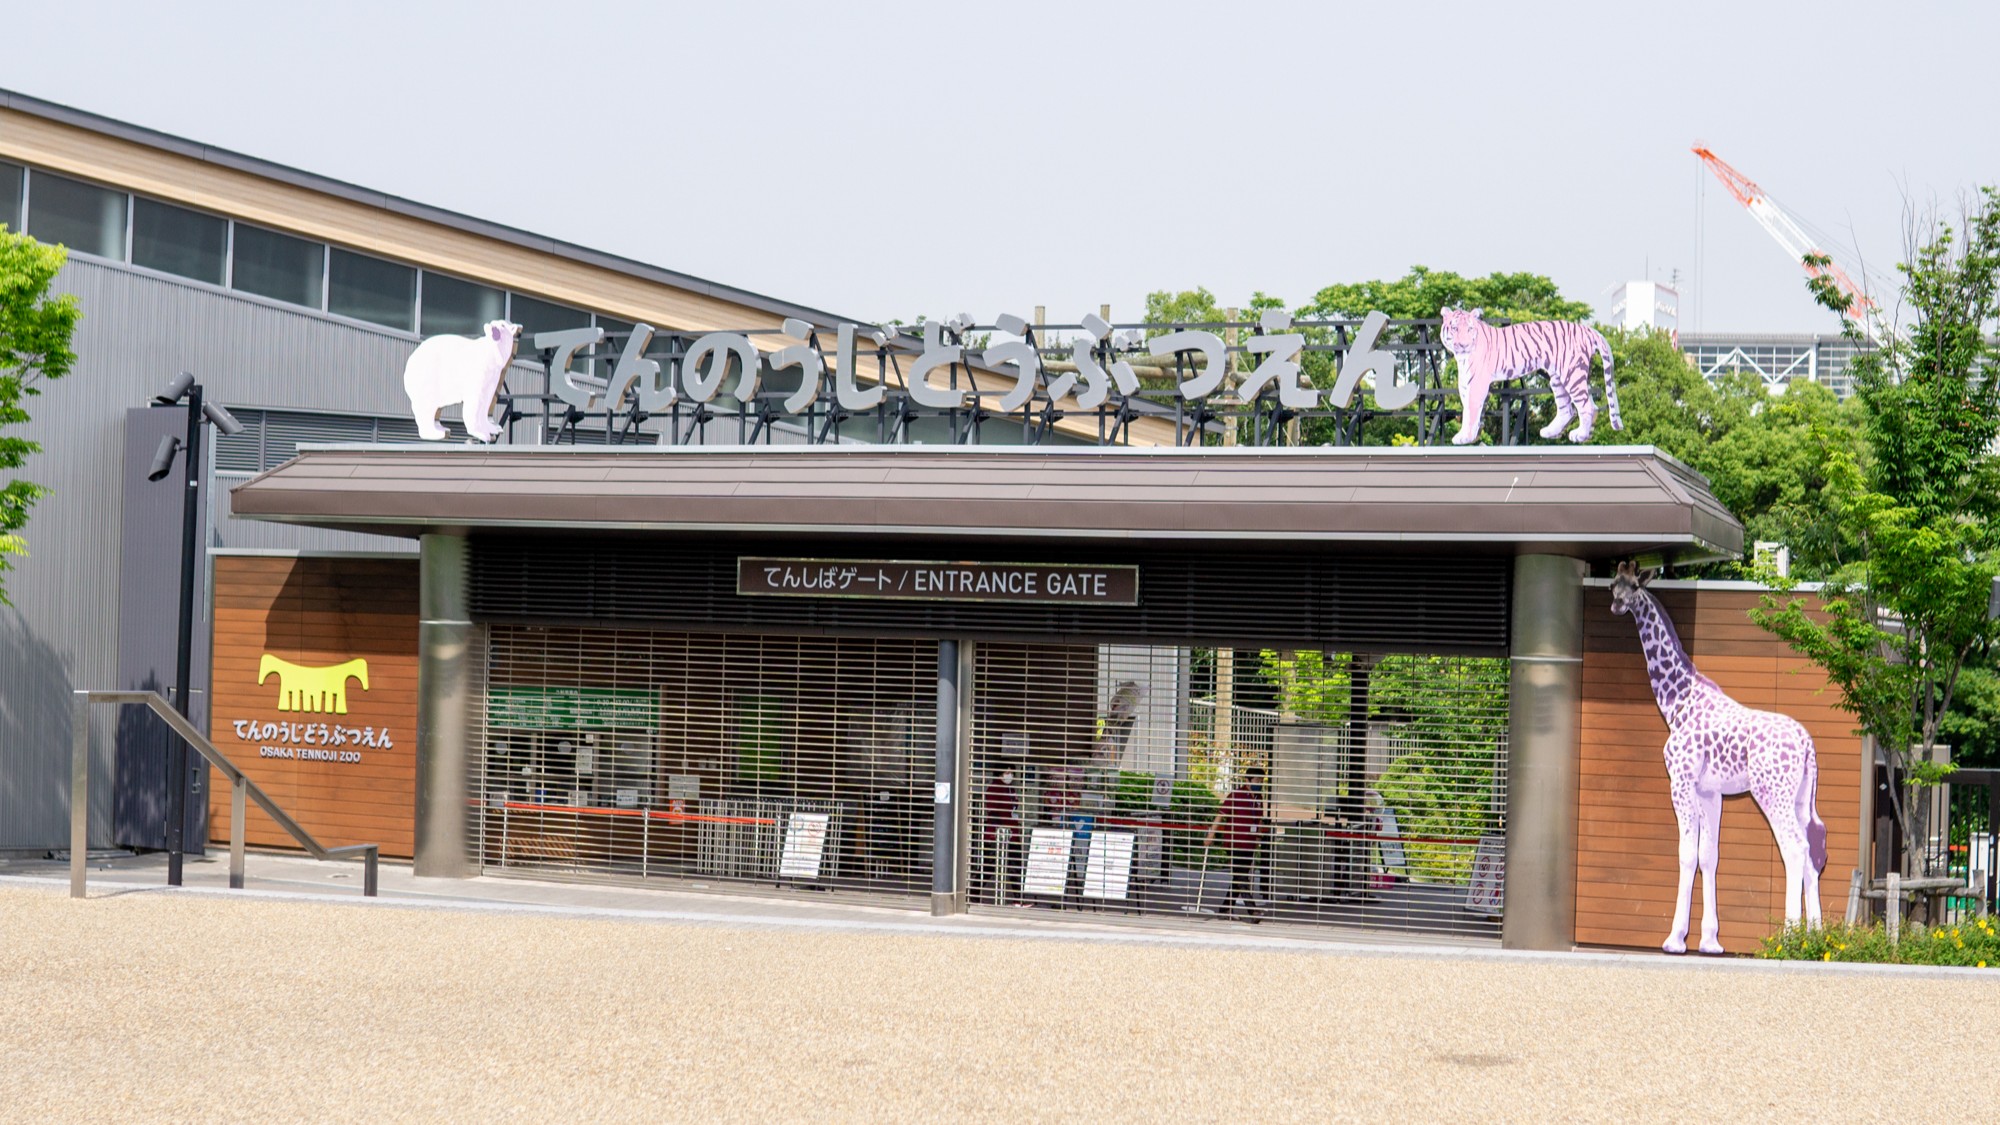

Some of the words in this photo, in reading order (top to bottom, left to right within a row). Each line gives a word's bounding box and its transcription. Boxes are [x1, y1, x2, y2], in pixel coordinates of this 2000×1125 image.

[533, 310, 1419, 413] てんのうじどうぶつえん
[764, 567, 892, 590] てんしばゲート
[914, 570, 1038, 594] ENTRANCE
[1046, 573, 1108, 596] GATE
[233, 719, 394, 749] てんのうじどうぶつえん
[260, 746, 294, 759] OSAKA
[296, 748, 338, 761] TENNOJI
[340, 751, 362, 763] ZOO
